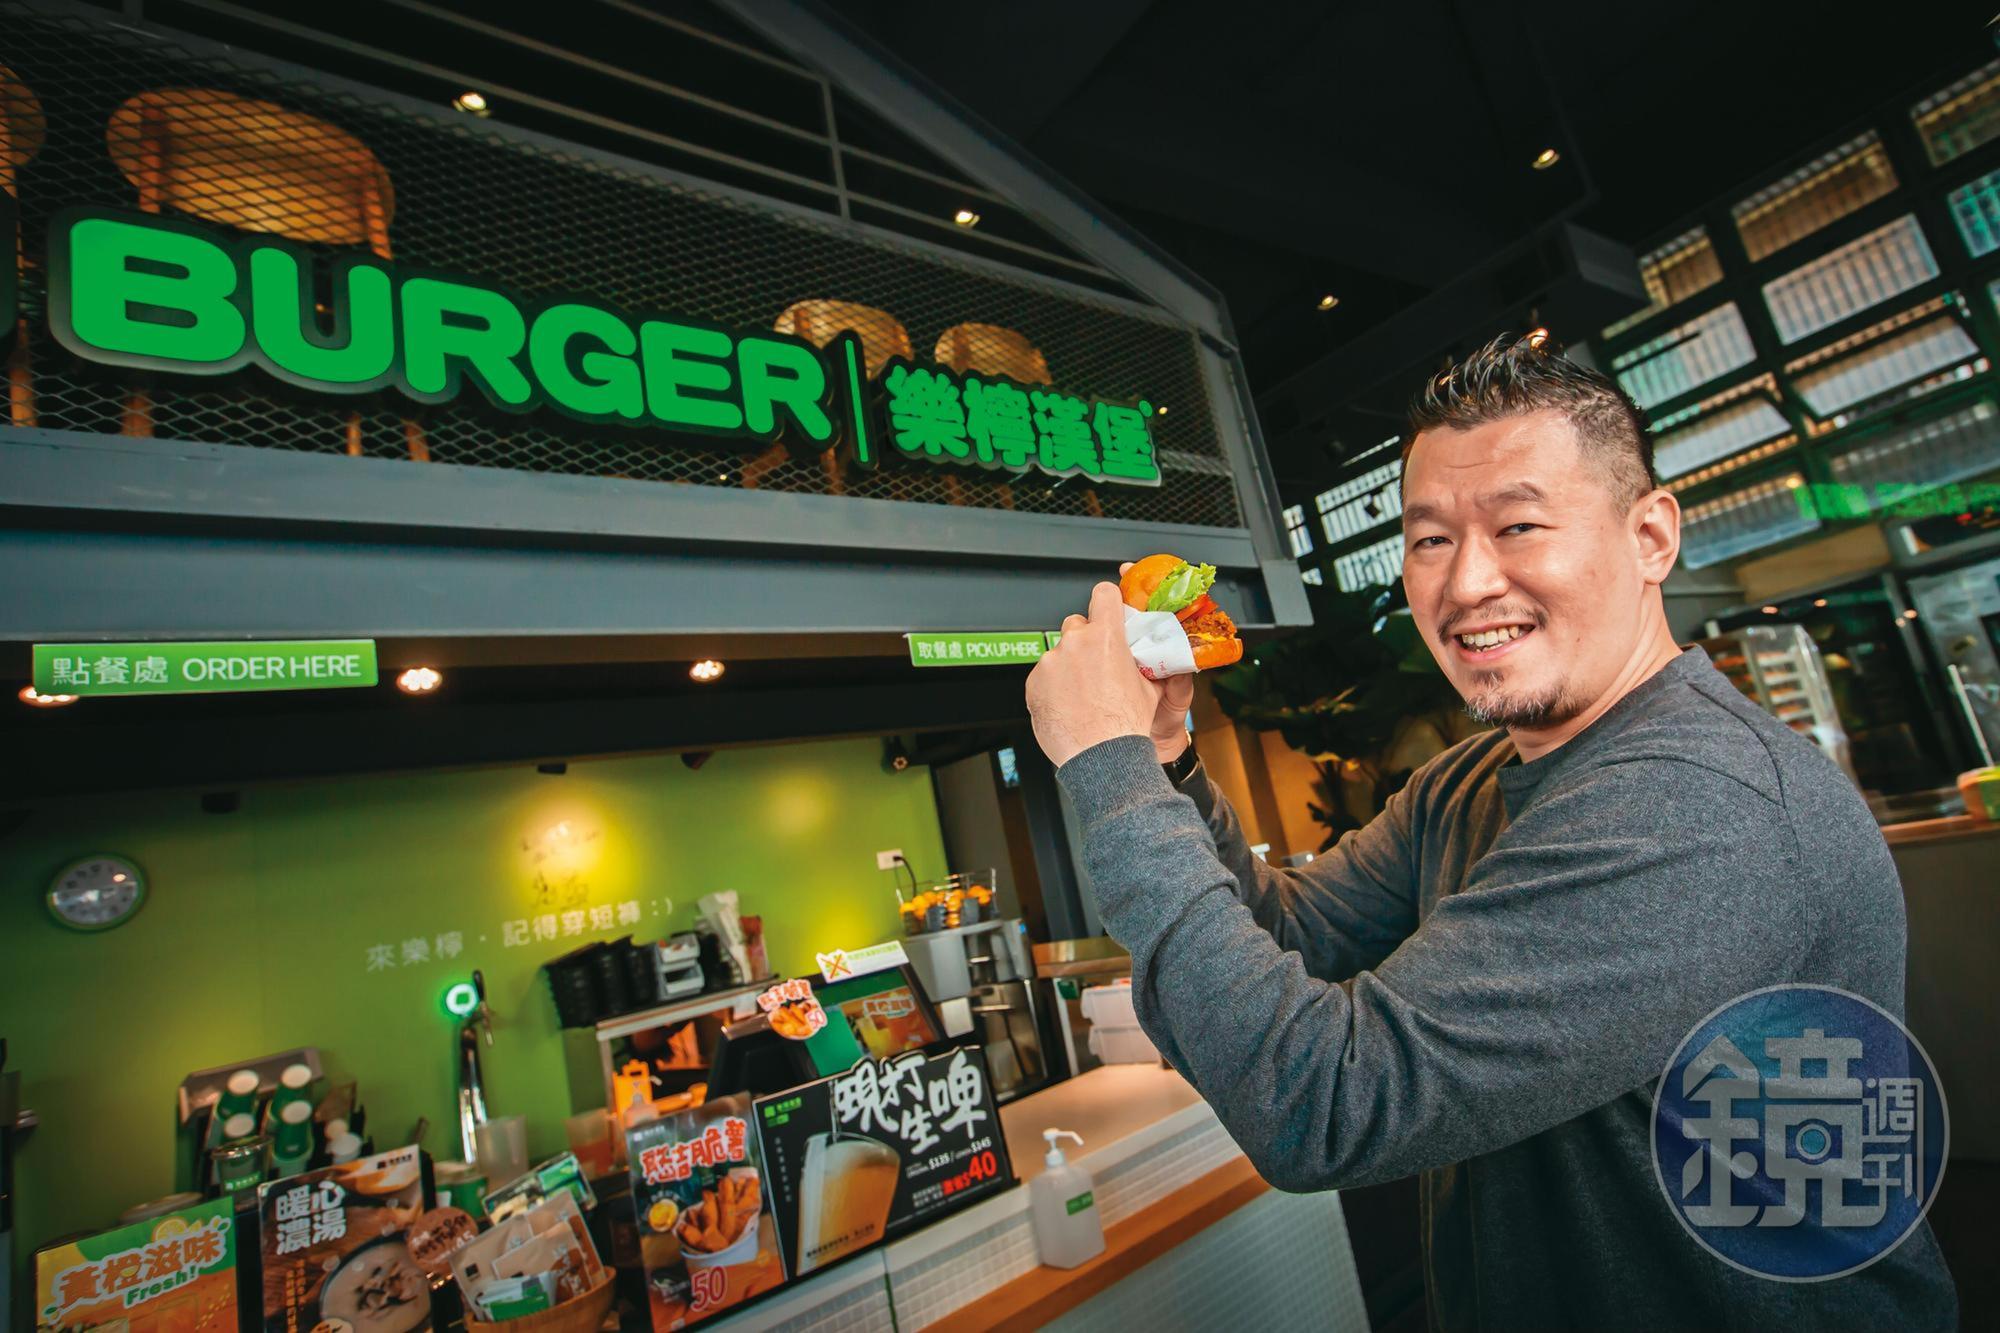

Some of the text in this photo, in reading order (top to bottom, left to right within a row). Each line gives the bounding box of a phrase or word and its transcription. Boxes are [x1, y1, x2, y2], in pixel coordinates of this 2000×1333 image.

[70, 218, 833, 443] BURGER
[885, 364, 1159, 480] 樂檸漢堡
[52, 656, 168, 685] 點餐處
[182, 654, 362, 682] ORDER HERE
[917, 641, 963, 659] 取餐處
[366, 931, 463, 973] 來樂檸
[502, 900, 641, 948] 記得穿短褲
[834, 1050, 987, 1155] 現打生啤
[275, 1180, 346, 1221] 暖心
[275, 1207, 347, 1255] 濃湯
[59, 1230, 221, 1309] 黃橙滋味
[125, 1265, 196, 1306] Fresh!
[692, 1266, 727, 1312] 50
